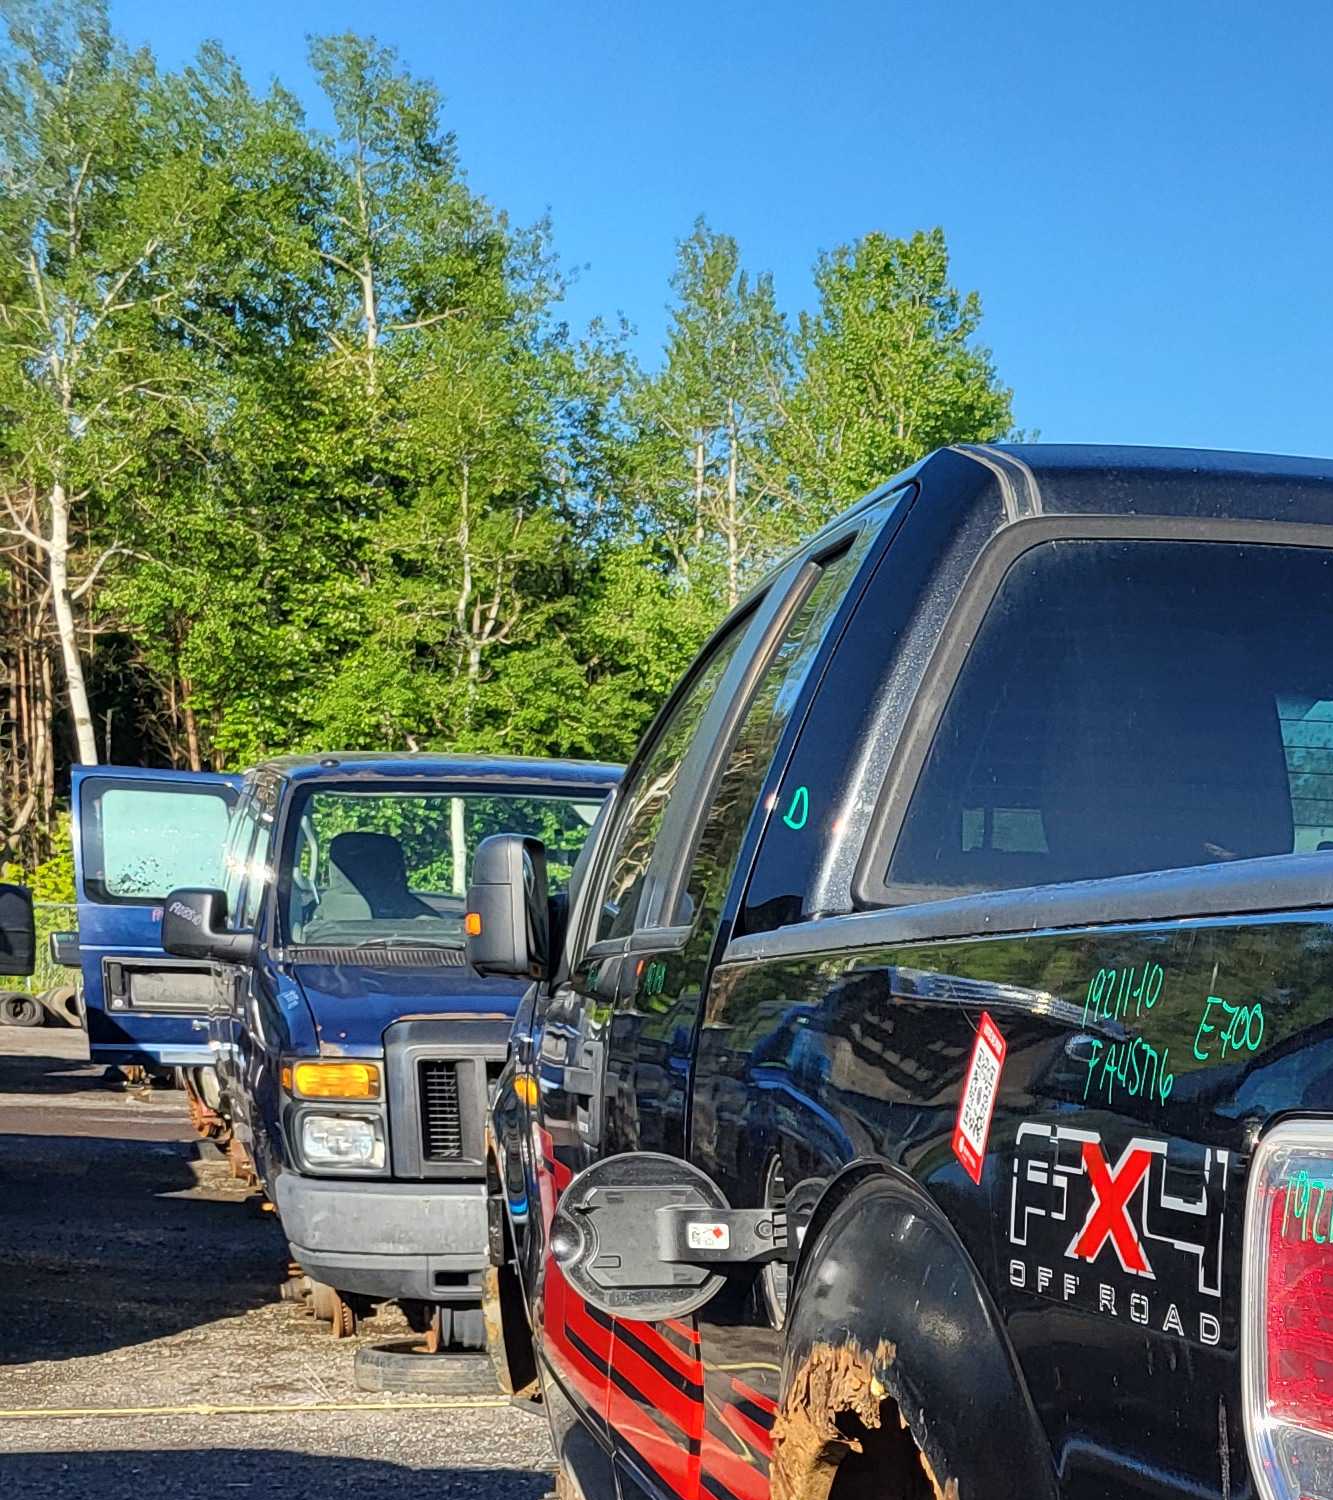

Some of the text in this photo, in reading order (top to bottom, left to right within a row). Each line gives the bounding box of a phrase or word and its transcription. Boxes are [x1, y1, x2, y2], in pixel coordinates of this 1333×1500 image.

[1194, 996, 1264, 1060] E700
[1009, 1122, 1229, 1298] FX4
[1009, 1259, 1221, 1346] OFF ROAD
